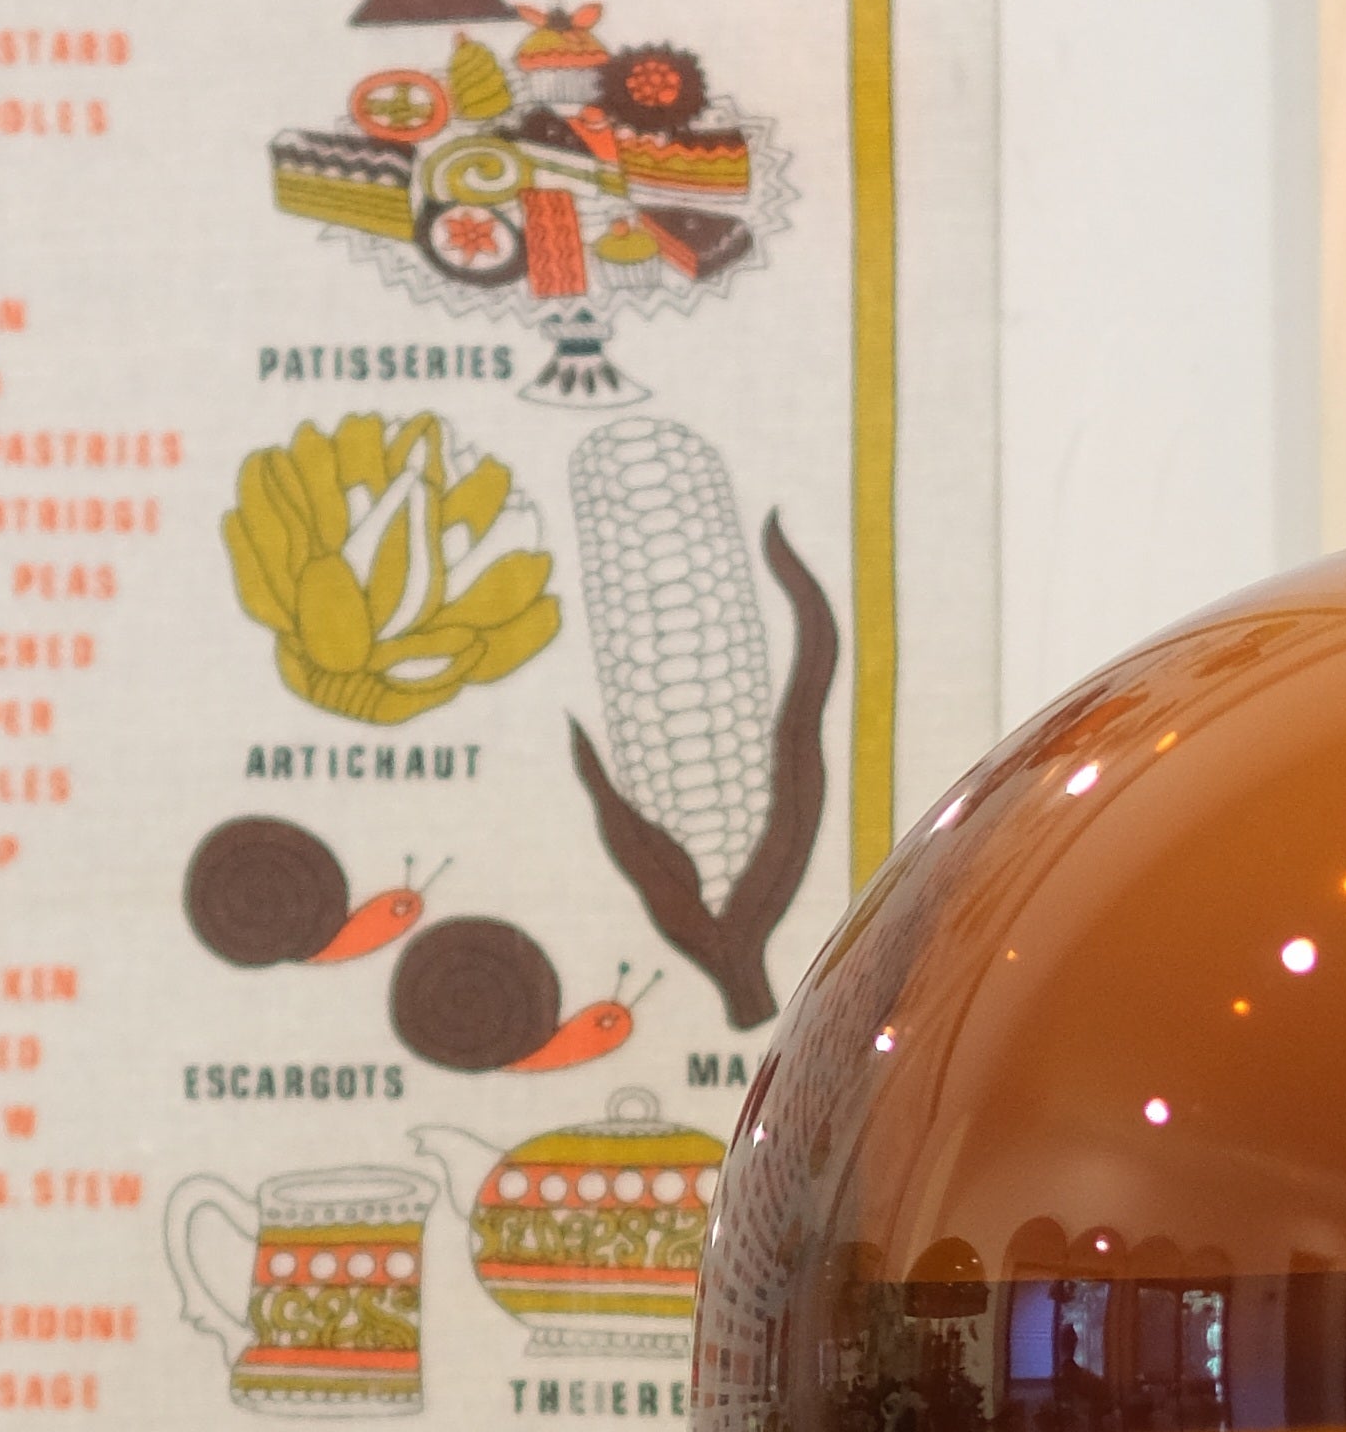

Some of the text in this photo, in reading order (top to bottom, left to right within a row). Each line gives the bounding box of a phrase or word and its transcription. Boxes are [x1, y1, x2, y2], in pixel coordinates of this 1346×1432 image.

[259, 345, 513, 381] PATISSERIES
[246, 745, 480, 780] ARTICHAUT
[184, 1064, 404, 1100] ESCARGOTS
[688, 1053, 763, 1086] MA
[510, 1379, 683, 1416] THEIERE
